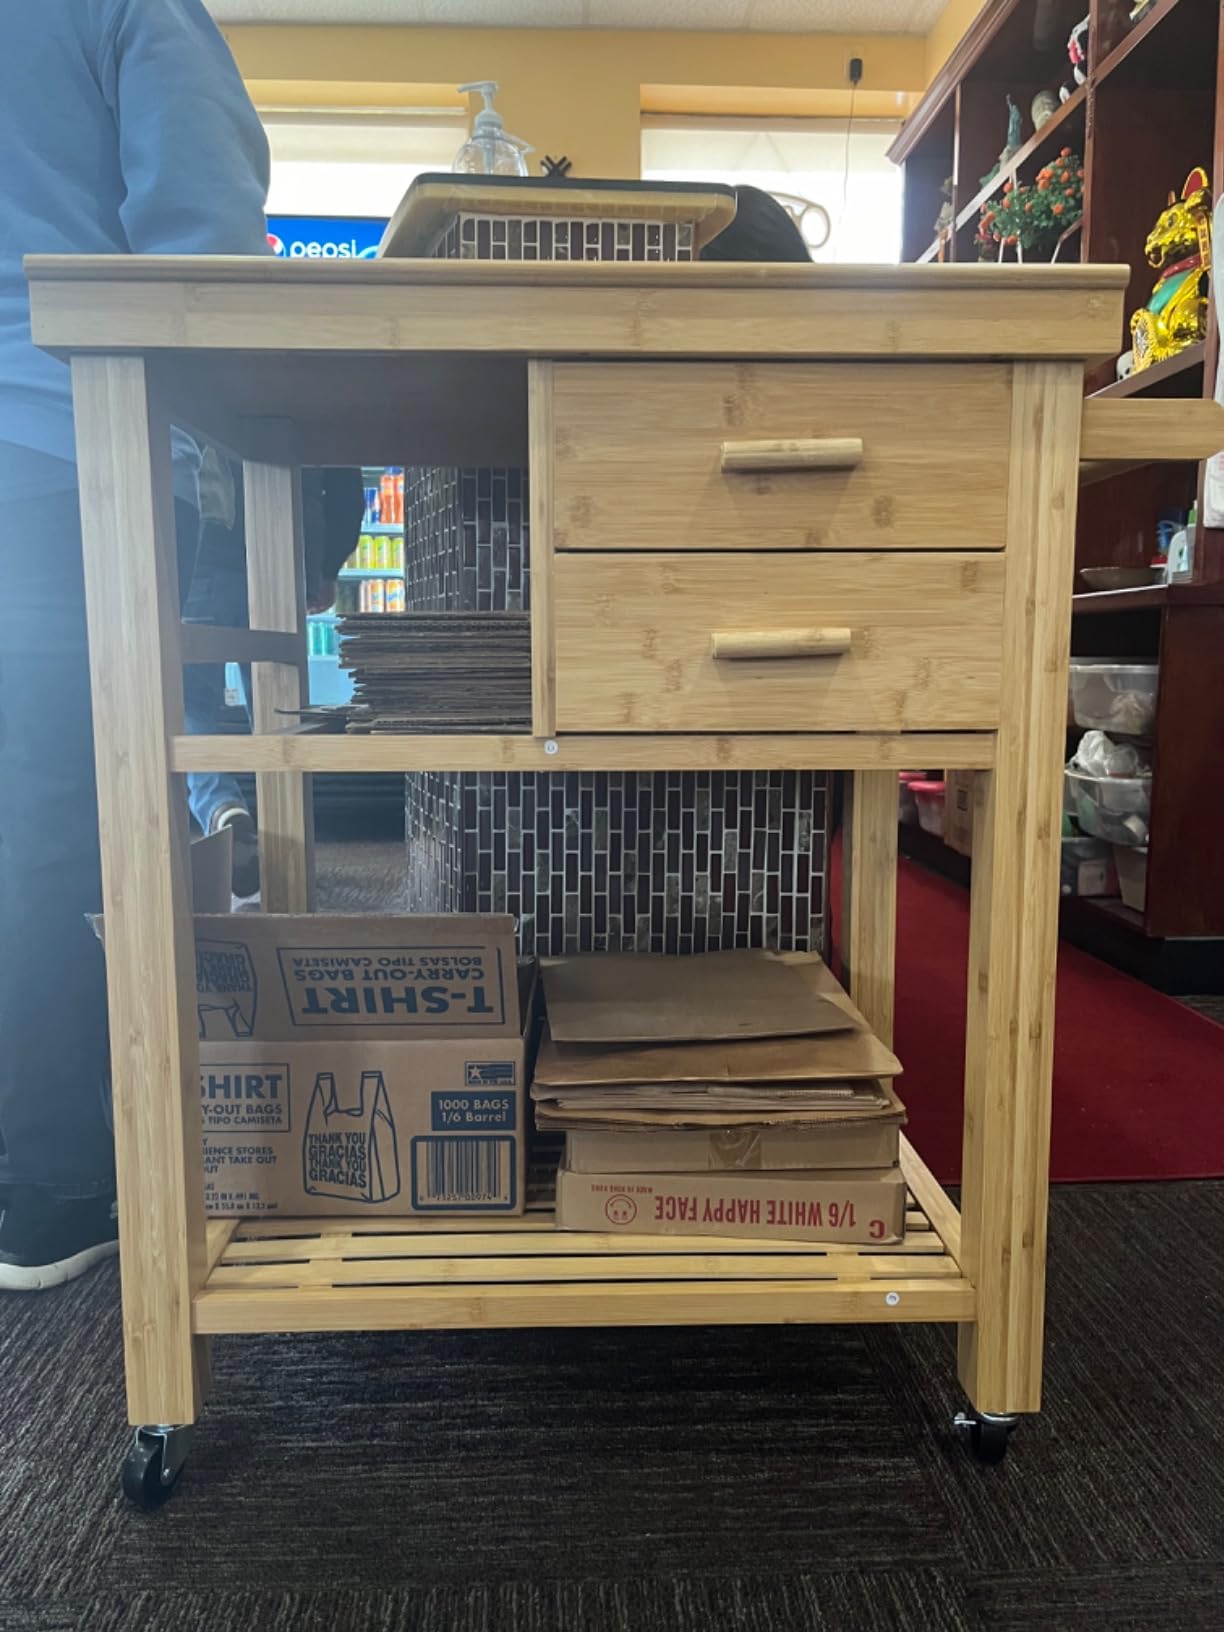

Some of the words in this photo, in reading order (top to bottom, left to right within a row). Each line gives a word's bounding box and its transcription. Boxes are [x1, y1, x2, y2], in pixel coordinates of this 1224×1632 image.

[290, 239, 356, 258] pepsi
[293, 957, 373, 967] CAMISETA
[378, 957, 415, 967] TIPO
[419, 956, 482, 966] BOLSAS
[294, 969, 354, 981] BAGS
[362, 968, 484, 981] CARRY-OUT
[302, 986, 493, 1014] T-SHIRT
[246, 1104, 282, 1115] BAGS
[439, 1099, 469, 1110] 1000
[474, 1099, 509, 1110] BAGS
[208, 1116, 231, 1125] TIPO
[234, 1116, 282, 1126] CAMISETA
[441, 1112, 461, 1125] 1/6
[466, 1111, 506, 1122] Barrel
[308, 1132, 342, 1145] THANK
[345, 1131, 366, 1145] YOU
[308, 1145, 367, 1161] GRACIAS
[309, 1157, 342, 1170] THANK
[345, 1159, 367, 1173] YOU
[308, 1168, 367, 1189] GRACIAS
[654, 1195, 697, 1222] FACE
[703, 1198, 760, 1224] HAPPY
[766, 1200, 823, 1226] WHITE
[828, 1200, 857, 1228] 1/6
[869, 1219, 886, 1239] C
